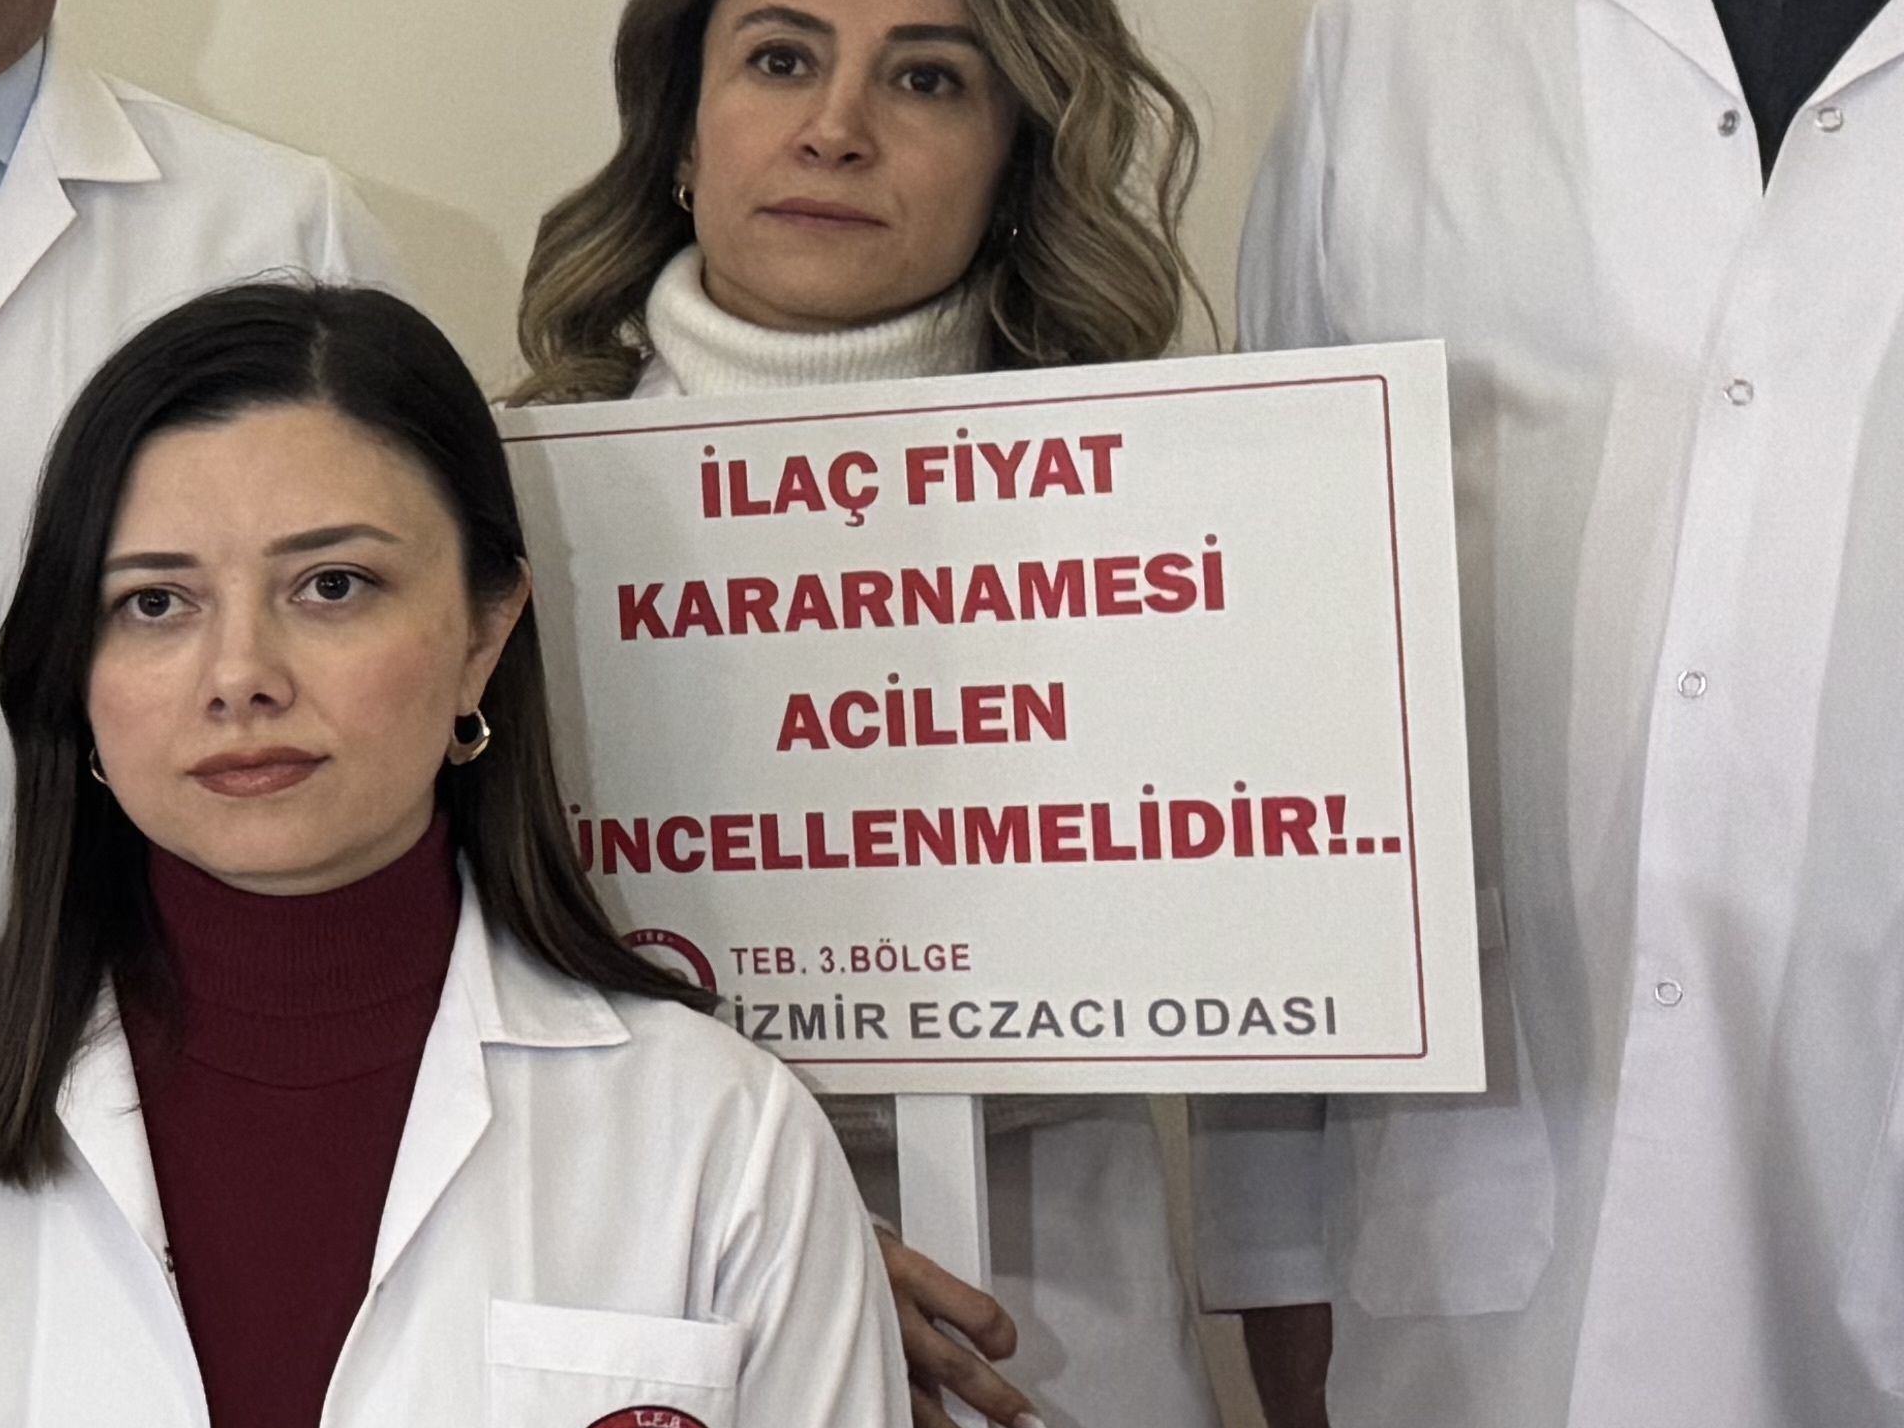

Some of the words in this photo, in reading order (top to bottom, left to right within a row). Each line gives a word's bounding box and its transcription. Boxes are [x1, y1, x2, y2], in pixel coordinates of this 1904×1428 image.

[700, 445, 879, 526] İLAÇ
[905, 428, 1123, 506] FİYAT
[617, 533, 1226, 641] KARARNAMESİ
[775, 672, 1068, 752] ACİLEN
[729, 945, 805, 977] TEB.
[733, 992, 889, 1043] İZMİR
[909, 999, 1125, 1039] ECZACI
[1147, 997, 1338, 1037] ODASI
